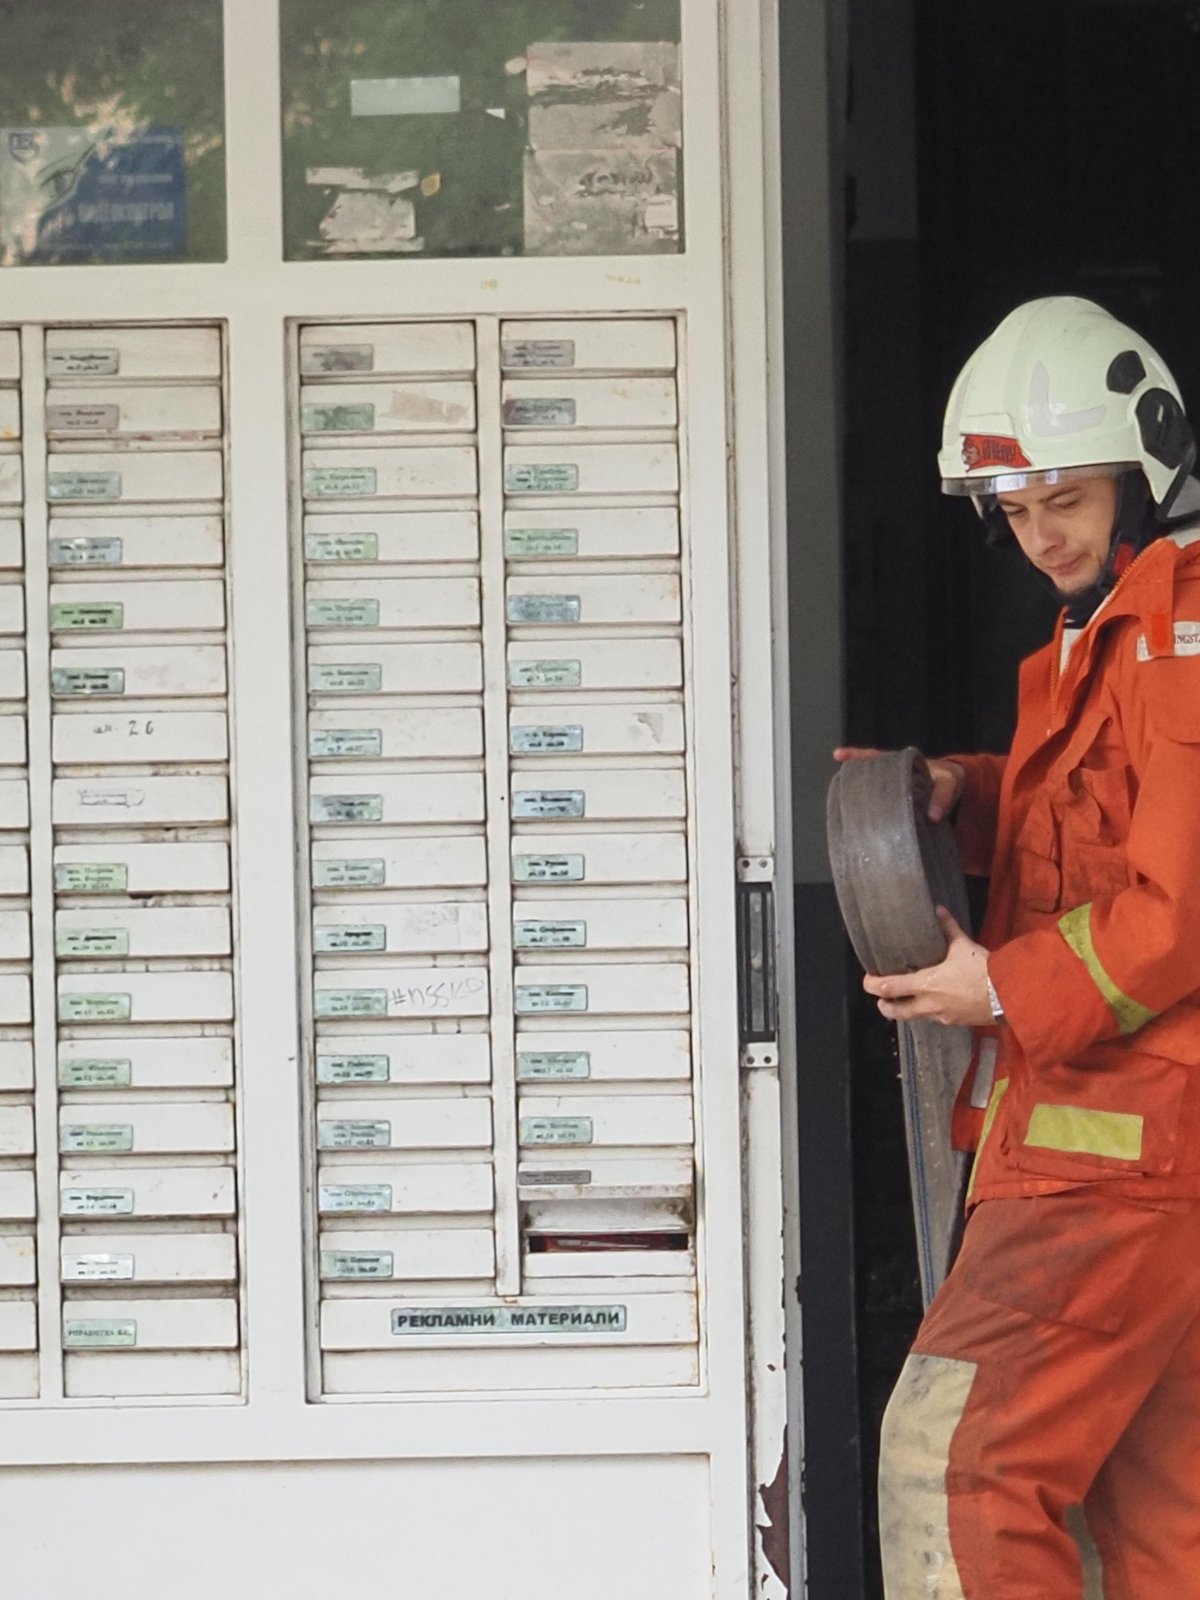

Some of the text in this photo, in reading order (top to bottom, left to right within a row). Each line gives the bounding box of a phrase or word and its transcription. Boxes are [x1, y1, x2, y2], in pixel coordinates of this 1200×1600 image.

[127, 719, 154, 736] 26
[397, 1311, 620, 1328] РЕКЛАМНИ МАТЕРИАЛИ
